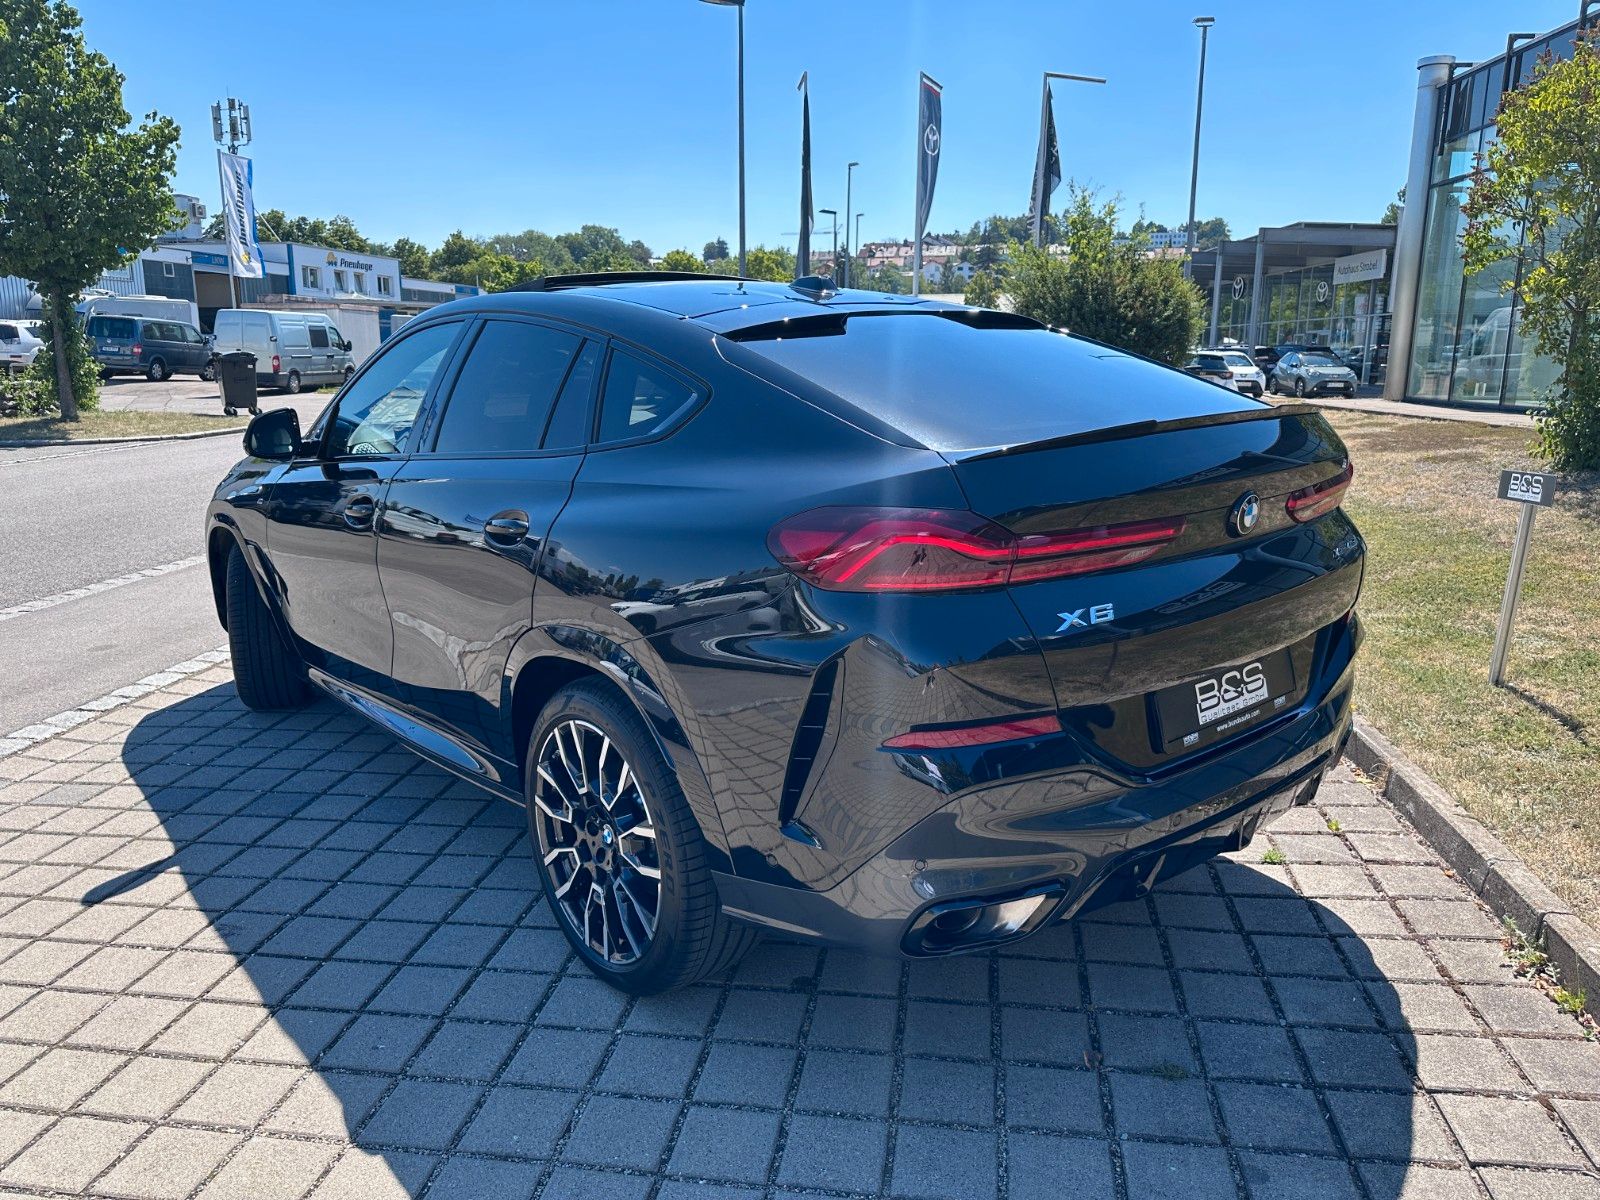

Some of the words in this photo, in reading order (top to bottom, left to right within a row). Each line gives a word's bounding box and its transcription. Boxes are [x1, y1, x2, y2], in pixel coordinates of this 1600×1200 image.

[340, 258, 373, 272] Pneuhage
[1509, 473, 1543, 495] B&S
[1055, 602, 1115, 633] X6
[1195, 662, 1265, 713] B&S
